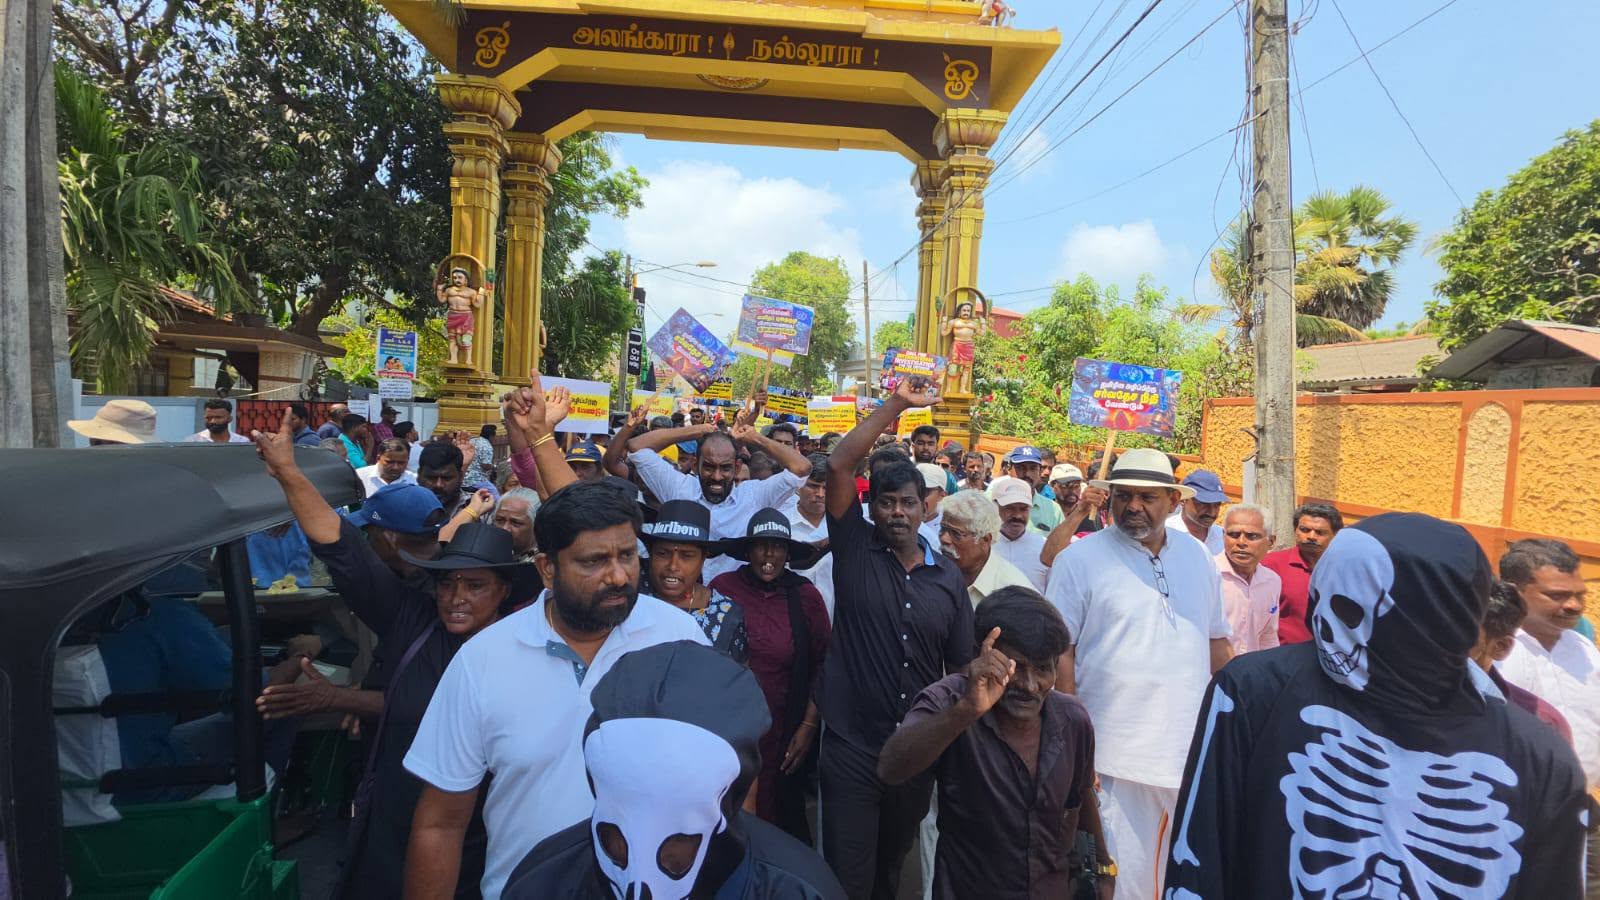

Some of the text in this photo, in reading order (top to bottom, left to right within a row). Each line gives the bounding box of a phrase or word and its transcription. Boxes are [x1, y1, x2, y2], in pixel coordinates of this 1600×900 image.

[1094, 388, 1138, 402] சர்வதேச
[653, 521, 700, 537] Marlboro
[753, 521, 790, 536] Marlboro
